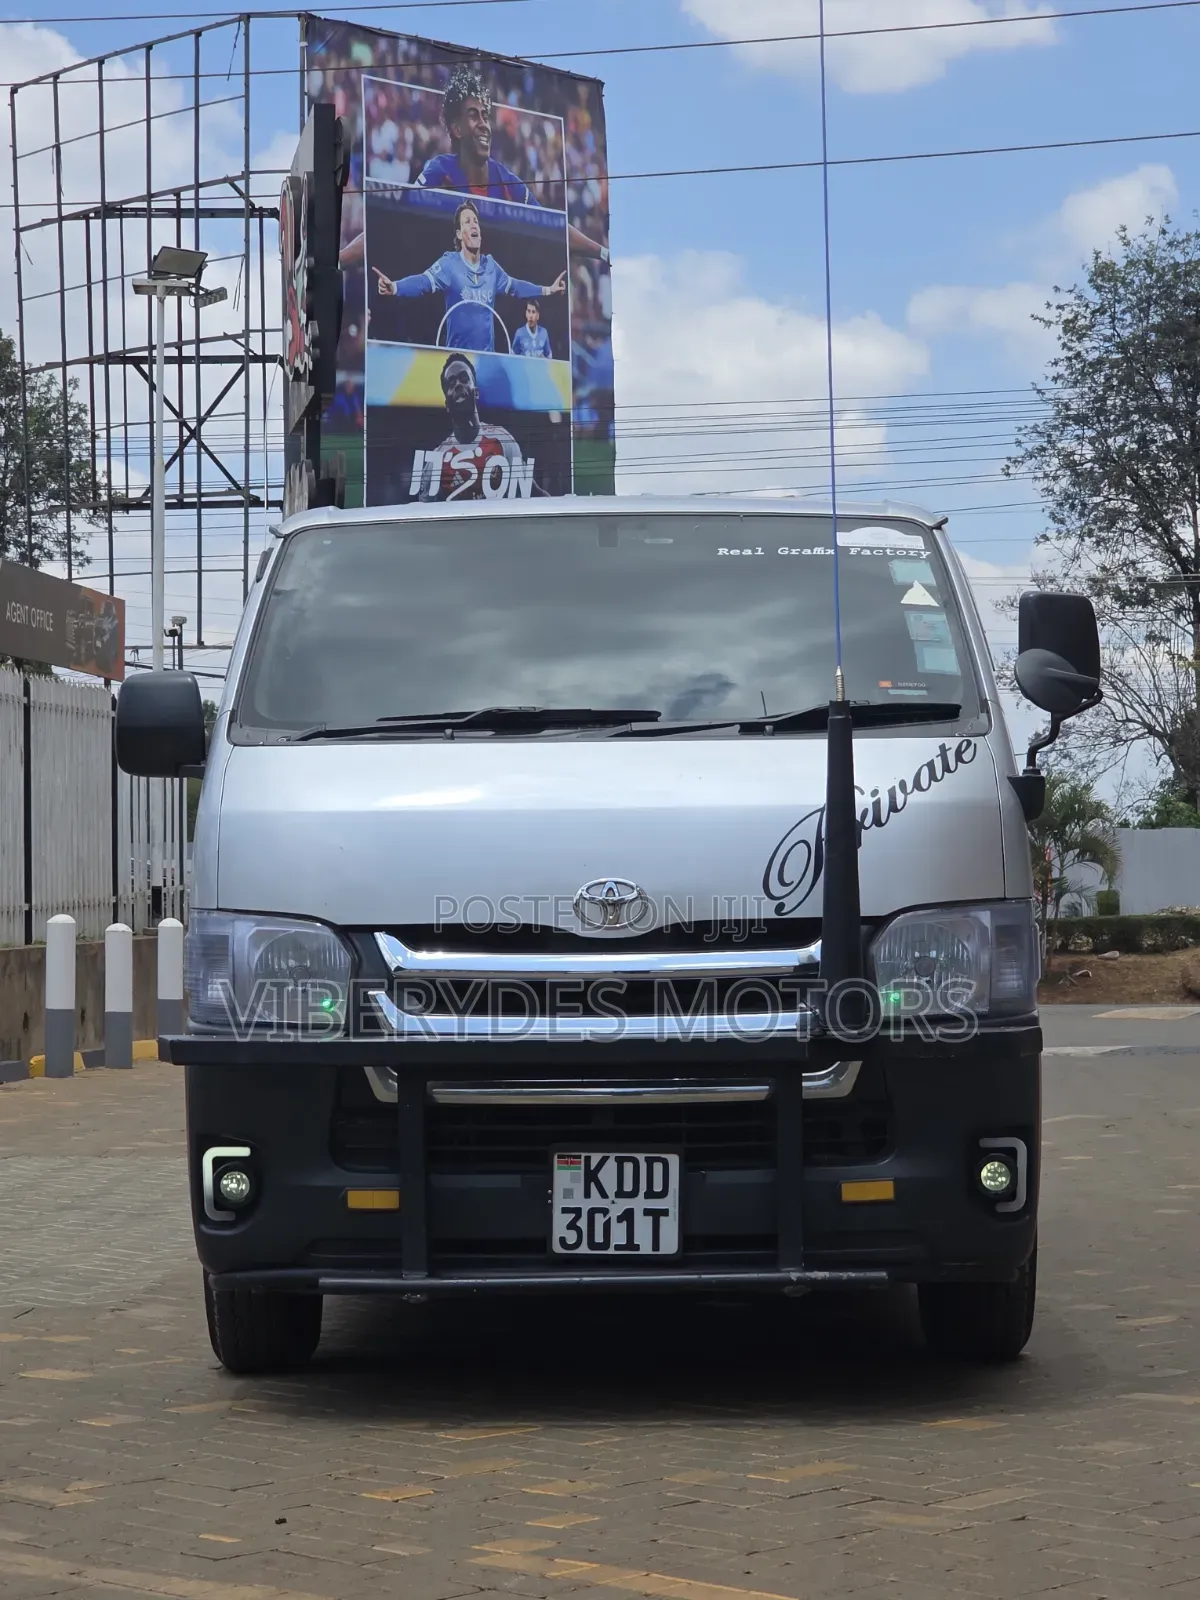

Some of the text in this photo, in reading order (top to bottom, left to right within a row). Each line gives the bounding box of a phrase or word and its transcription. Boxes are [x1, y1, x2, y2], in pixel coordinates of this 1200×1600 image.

[482, 454, 535, 500] ON
[716, 546, 765, 556] Real
[849, 547, 932, 559] Factory
[5, 601, 53, 632] AGENT OFFICE
[583, 1155, 670, 1199] KDD
[558, 1206, 670, 1252] 301T
